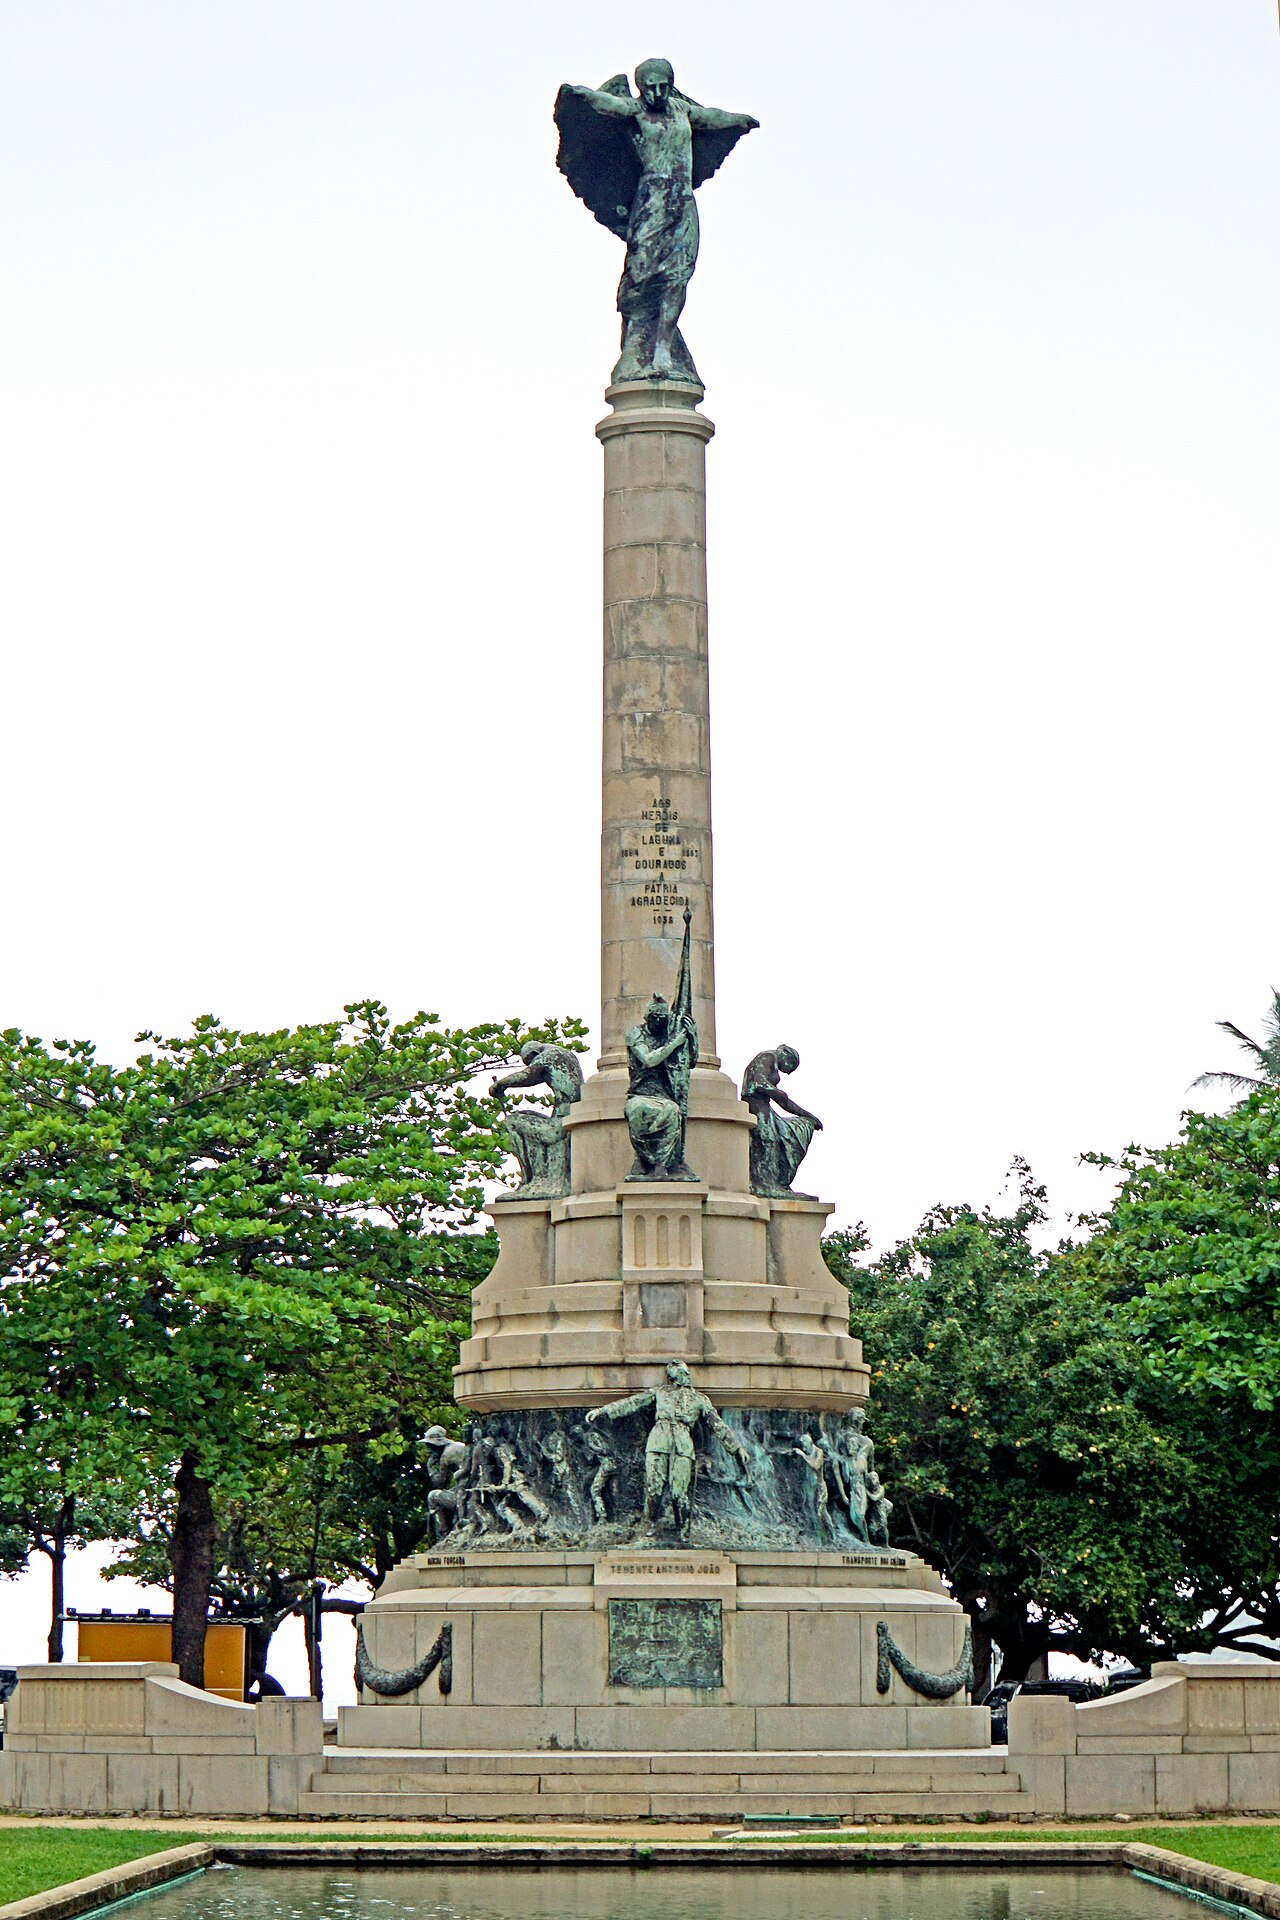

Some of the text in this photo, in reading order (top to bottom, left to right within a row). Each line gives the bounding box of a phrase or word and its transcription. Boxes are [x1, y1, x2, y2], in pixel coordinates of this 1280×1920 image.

[652, 798, 671, 808] AOS
[655, 823, 668, 833] DE
[641, 835, 681, 845] LAGUNA
[658, 847, 665, 857] E
[635, 860, 687, 870] DOURADOS
[659, 871, 665, 881] A
[631, 896, 689, 906] AGRADECIDA
